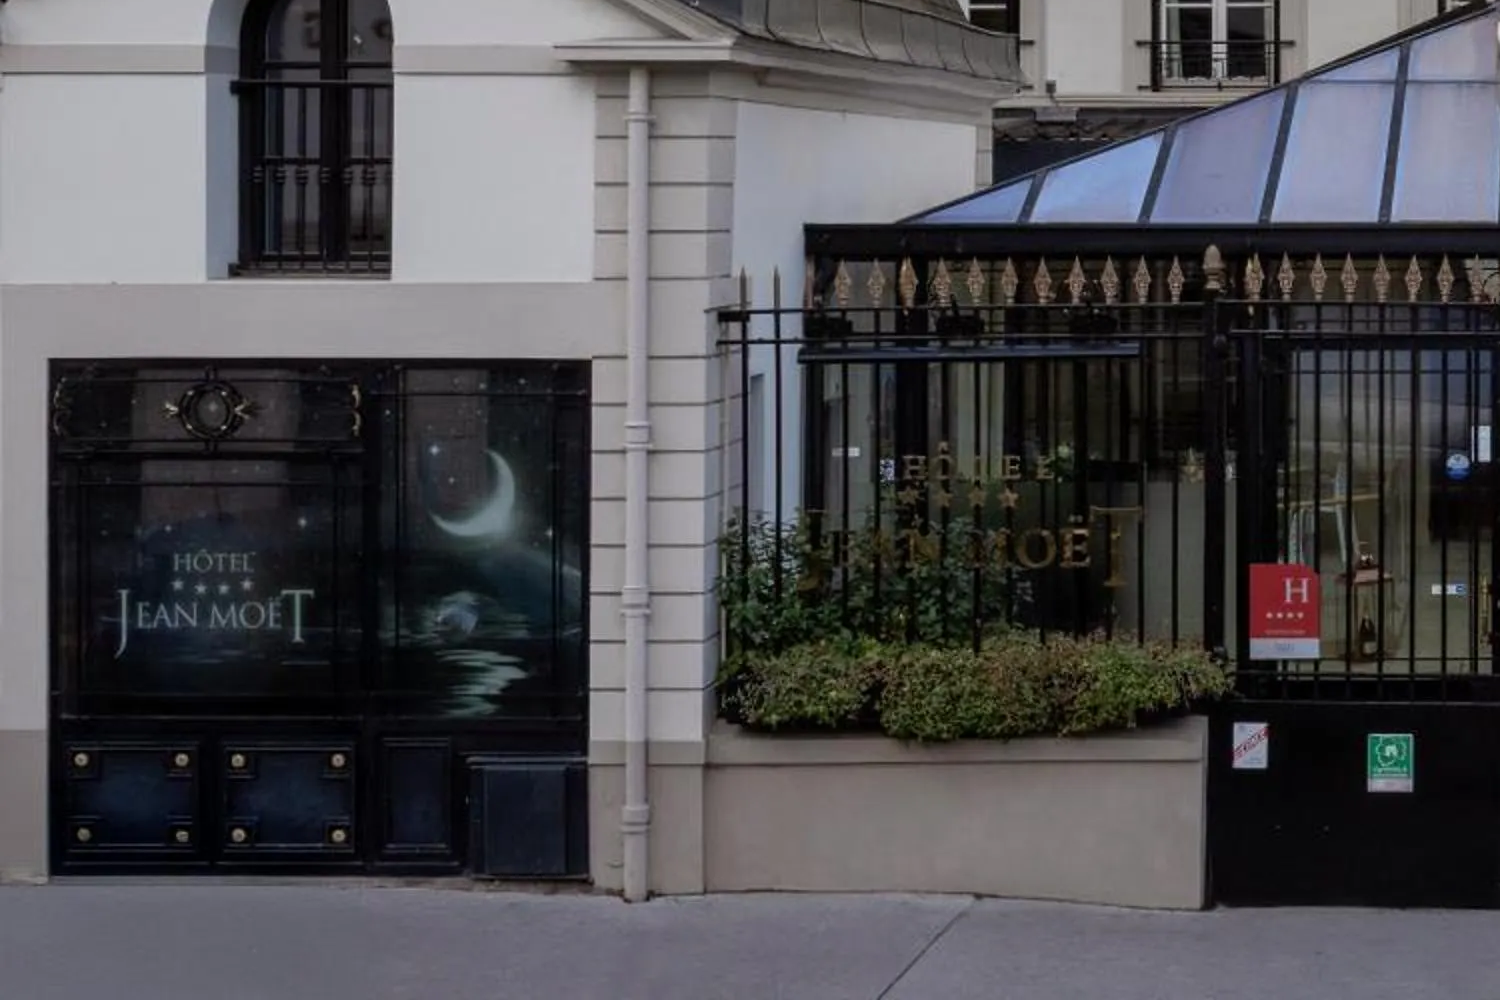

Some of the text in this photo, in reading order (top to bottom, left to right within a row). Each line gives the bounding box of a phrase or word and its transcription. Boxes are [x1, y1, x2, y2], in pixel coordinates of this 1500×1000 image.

[173, 548, 256, 573] HÔTEL
[1282, 577, 1312, 604] H
[113, 588, 315, 660] JEAN MOËT
